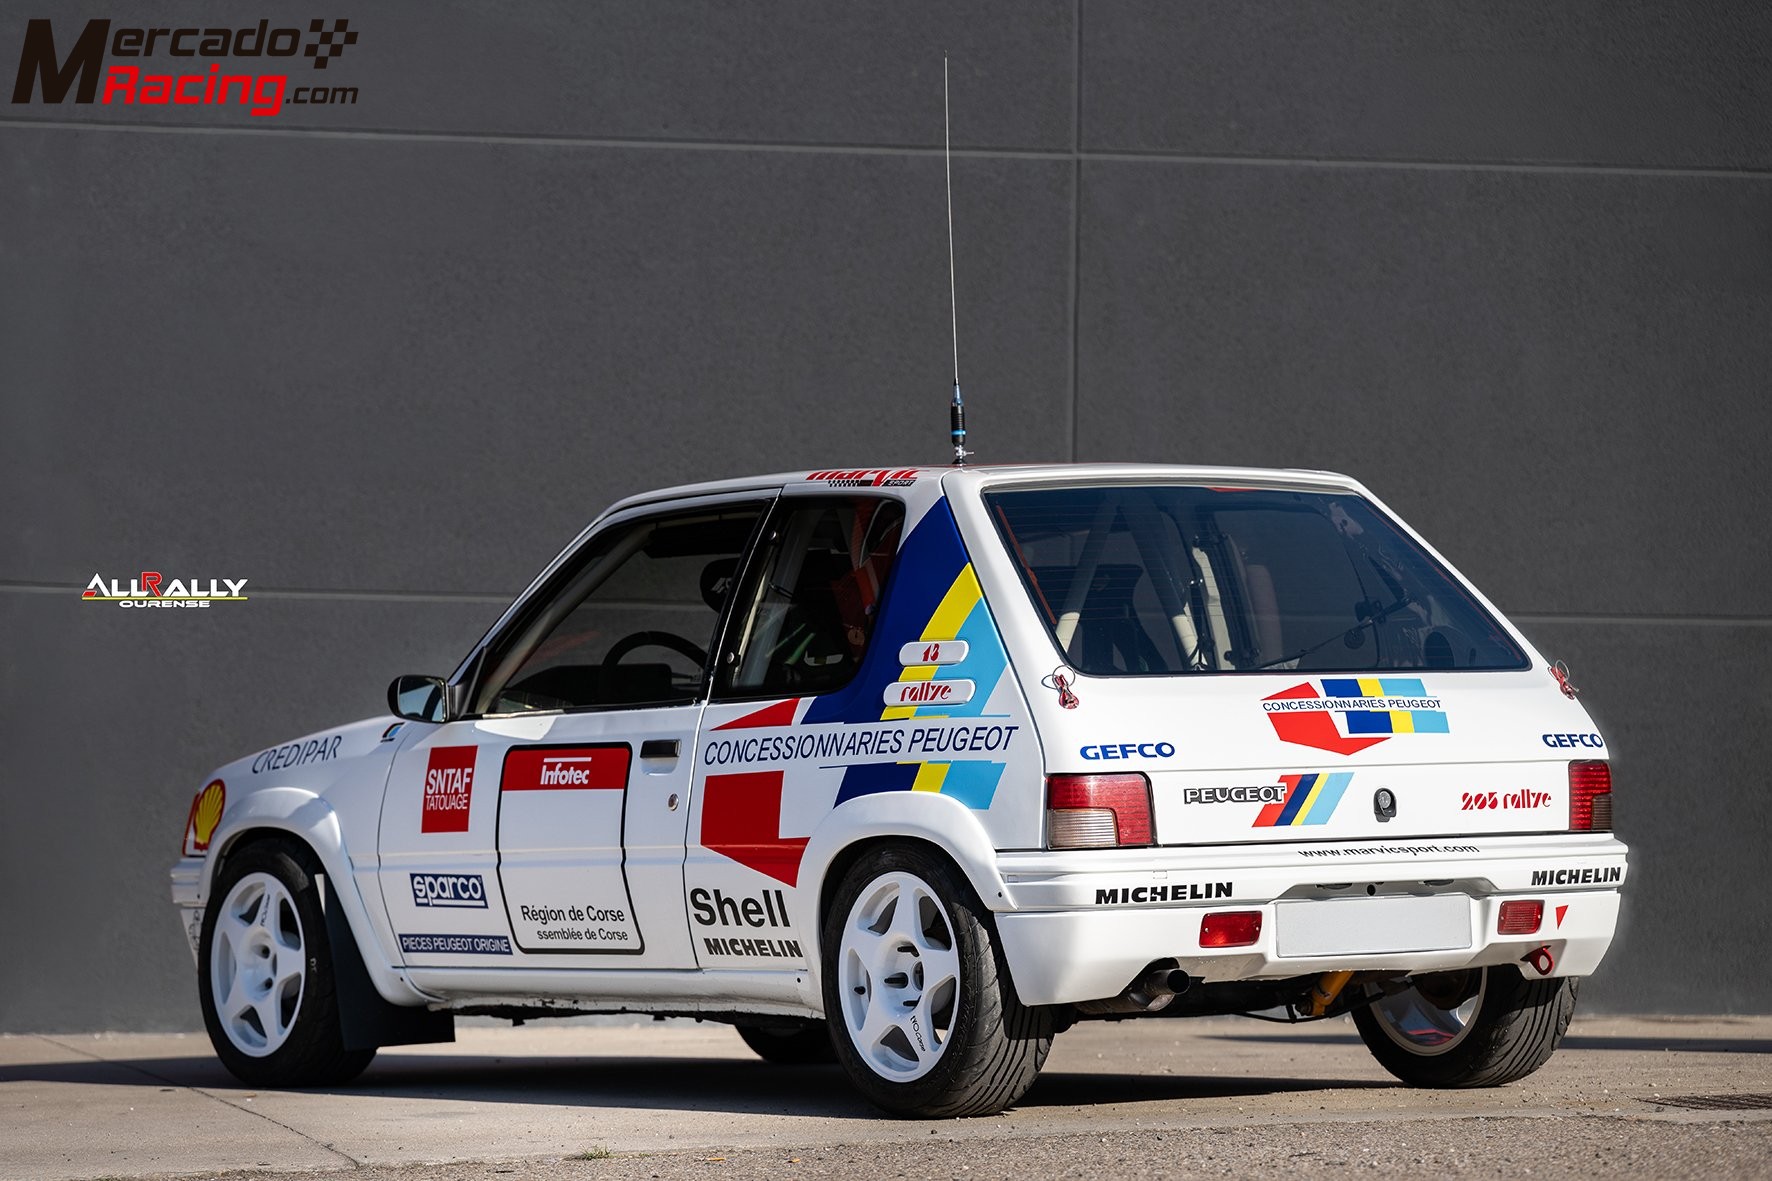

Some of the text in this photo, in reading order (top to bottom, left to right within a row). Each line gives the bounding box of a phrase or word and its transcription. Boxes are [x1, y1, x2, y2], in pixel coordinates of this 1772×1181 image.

[900, 682, 952, 702] rallye
[1262, 699, 1441, 712] CONCESSIONNARIES PEUGEOT
[704, 726, 1019, 766] CONCESSIONNARIES PEUGEOT
[1542, 733, 1603, 748] GEFCO
[252, 735, 342, 774] CREDIPAR
[1080, 742, 1175, 760] GEFCO
[426, 768, 472, 795] SNTAF
[540, 763, 590, 785] Infotec
[425, 794, 469, 811] TATOUAGE
[1184, 785, 1288, 804] PEUGEOT
[1461, 789, 1552, 810] 205 rallye
[1298, 845, 1480, 858] www.marvicsport.com
[1531, 867, 1621, 886] MICHELIN
[413, 873, 483, 906] sparco
[1095, 882, 1233, 905] MICHELIN
[521, 905, 625, 925] Région de Corse
[690, 888, 791, 927] Shell
[402, 936, 510, 952] PIECES PEUGEOT ORIGINE
[537, 927, 629, 941] ssemblée de Corse
[704, 938, 803, 958] MICHELIN
